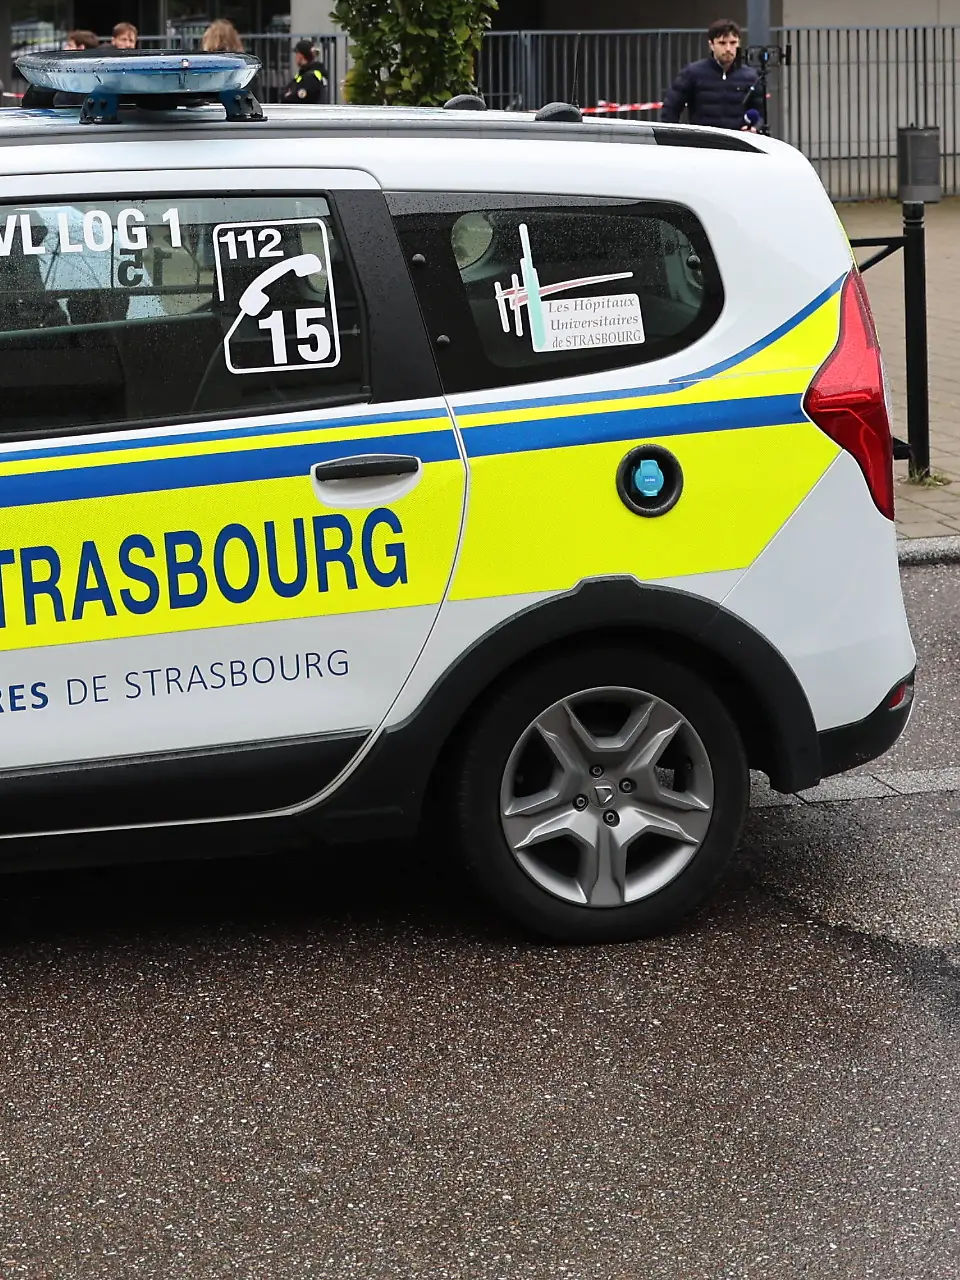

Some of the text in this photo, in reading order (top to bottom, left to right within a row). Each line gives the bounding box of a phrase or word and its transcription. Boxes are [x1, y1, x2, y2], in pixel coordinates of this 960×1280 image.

[58, 207, 148, 252] LOG
[161, 208, 183, 248] 1
[218, 228, 284, 260] 112
[548, 298, 635, 313] Les Hôpitaux
[258, 307, 331, 365] 15
[550, 314, 639, 331] Universitaires
[552, 330, 641, 349] de STRASBOURG
[66, 674, 109, 707] DE
[124, 649, 350, 700] STRASBOURG
